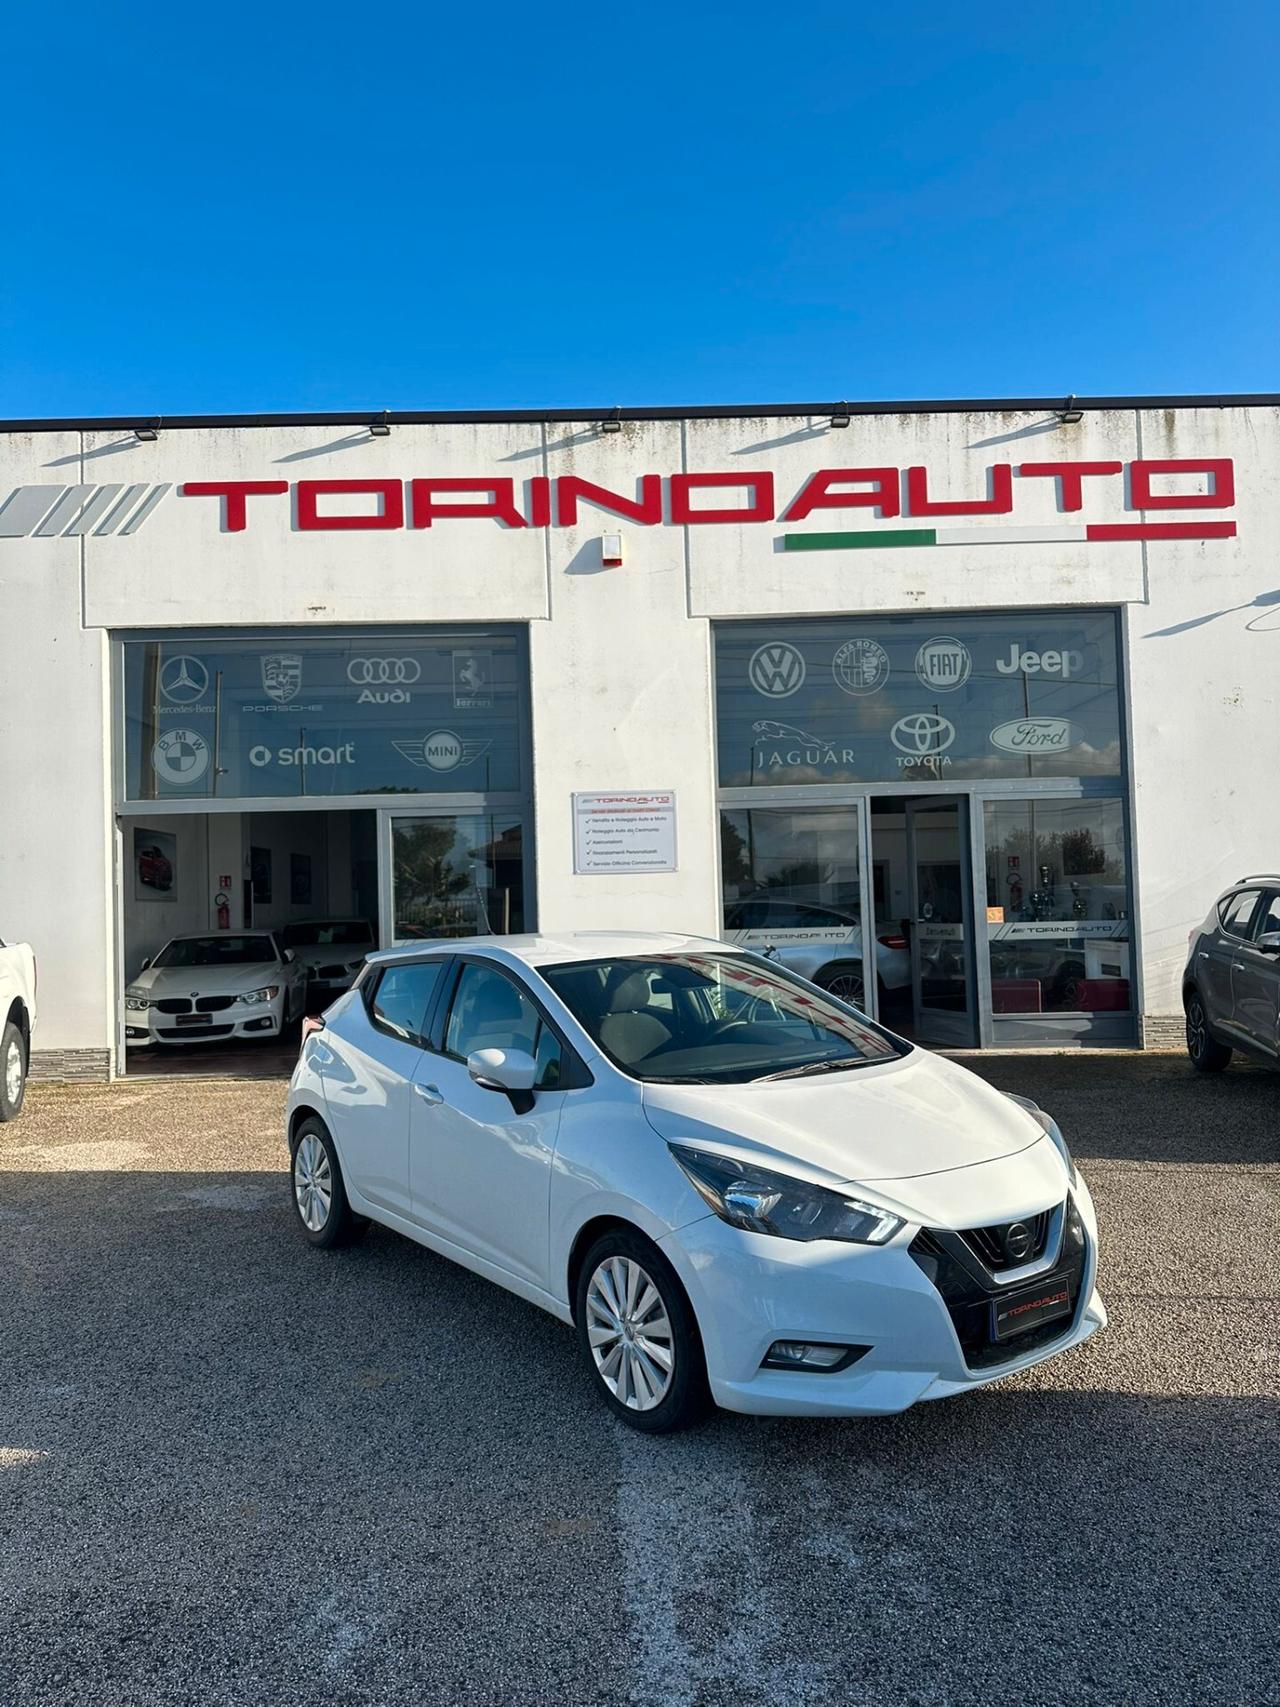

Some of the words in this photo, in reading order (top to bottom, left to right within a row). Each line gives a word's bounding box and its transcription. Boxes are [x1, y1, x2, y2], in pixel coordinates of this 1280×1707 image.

[183, 458, 1235, 531] TORINOAUTO
[928, 653, 960, 677] FIAT
[996, 643, 1084, 678] Jeep
[356, 688, 411, 704] Audi
[153, 704, 216, 714] Mercedes-Benz
[242, 704, 323, 712] PORSCHE
[1011, 723, 1066, 746] Ford
[278, 744, 355, 766] smart
[427, 745, 459, 757] MINI
[757, 749, 856, 768] JAGUAR
[895, 755, 952, 768] TOYOTA
[1026, 925, 1112, 934] TORINOAUTO
[1008, 1292, 1067, 1317] TORINOAUTO
